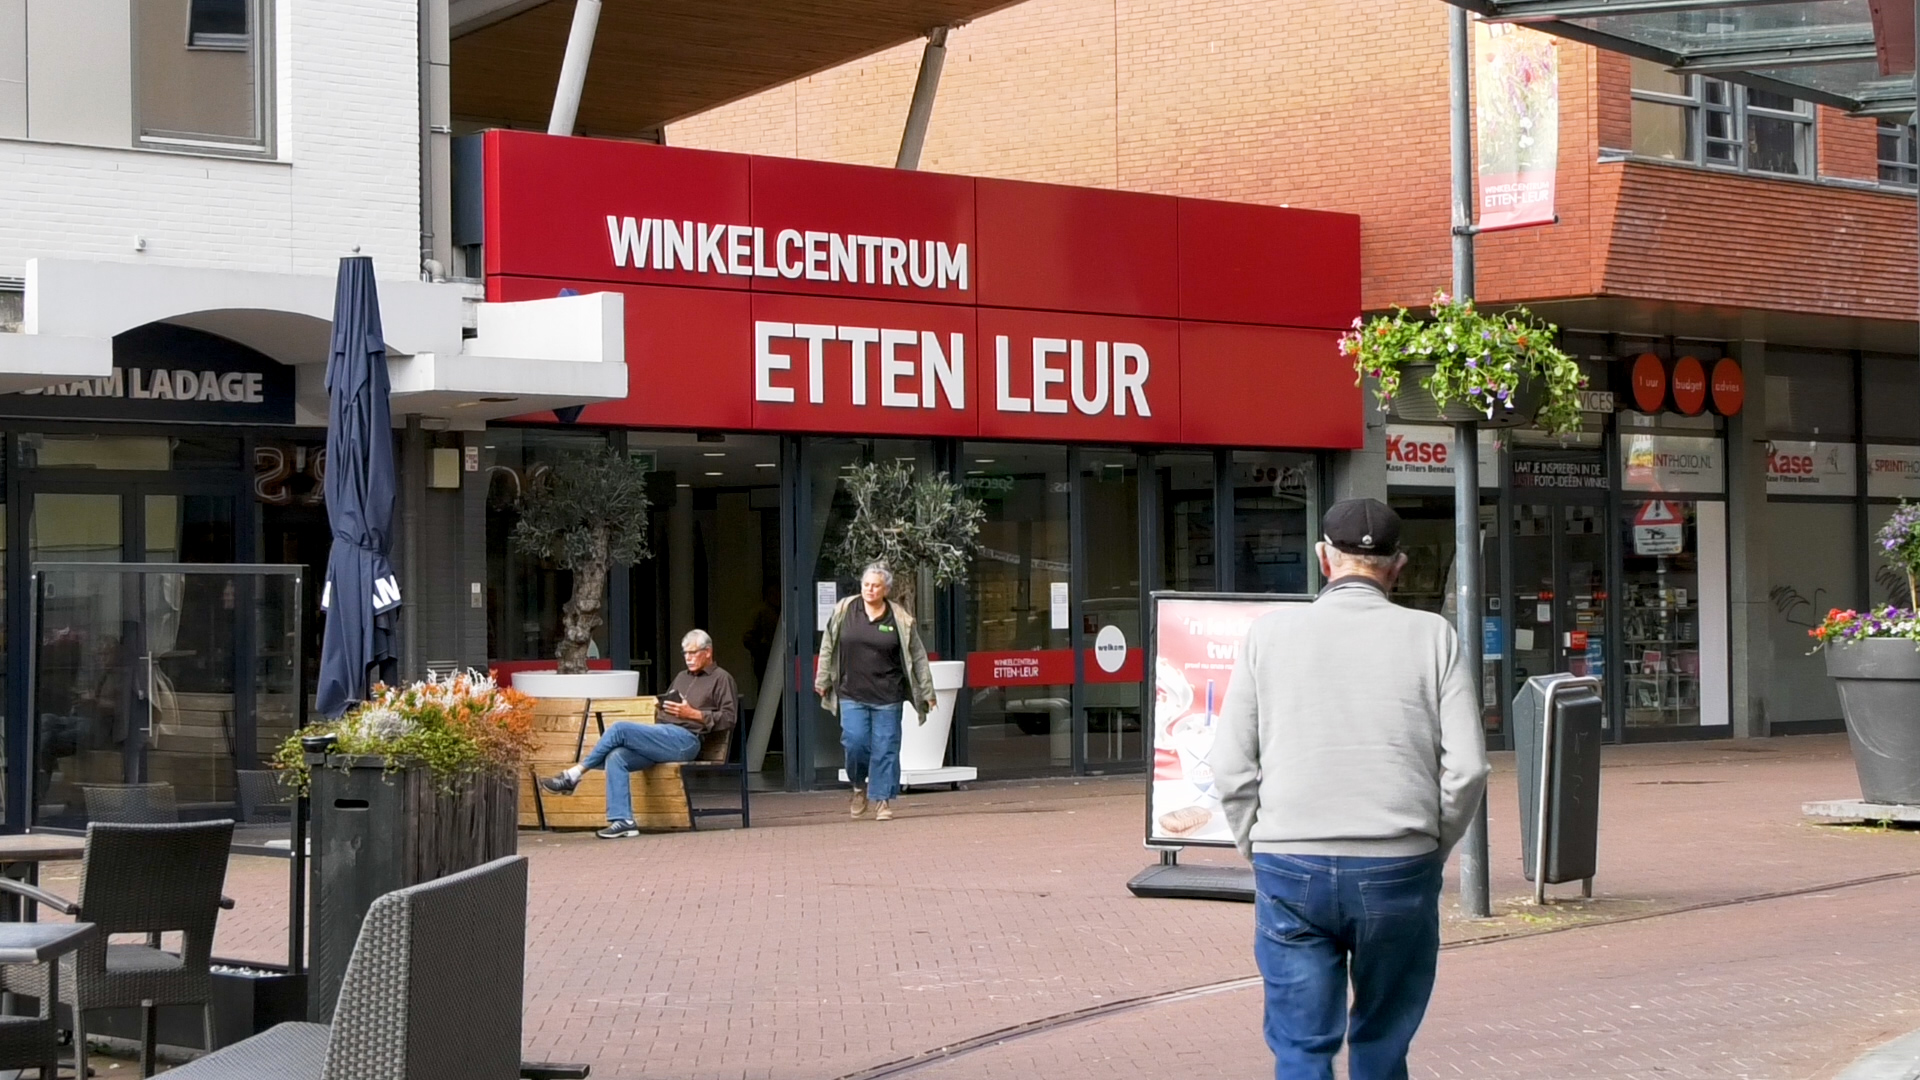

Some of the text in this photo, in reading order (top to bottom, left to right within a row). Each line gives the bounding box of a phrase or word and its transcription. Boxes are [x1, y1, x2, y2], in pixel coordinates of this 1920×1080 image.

[1484, 190, 1549, 207] ETTEN-LEUR
[606, 215, 968, 290] WINKELCENTRUM
[755, 321, 1152, 417] ETTEN LEUR
[128, 368, 264, 403] LADAGE
[1675, 379, 1703, 393] budget
[1715, 381, 1740, 392] advies
[1386, 434, 1447, 464] Kase
[1386, 464, 1403, 472] Kase
[1405, 464, 1427, 473] Filters
[1514, 462, 1601, 476] LAAT JE INSPIREREN IN DE
[1766, 452, 1814, 475] Kase
[1097, 643, 1125, 651] welkom
[993, 658, 1039, 666] WINKELCENTRUM
[993, 666, 1039, 679] ETTEN-LEUR
